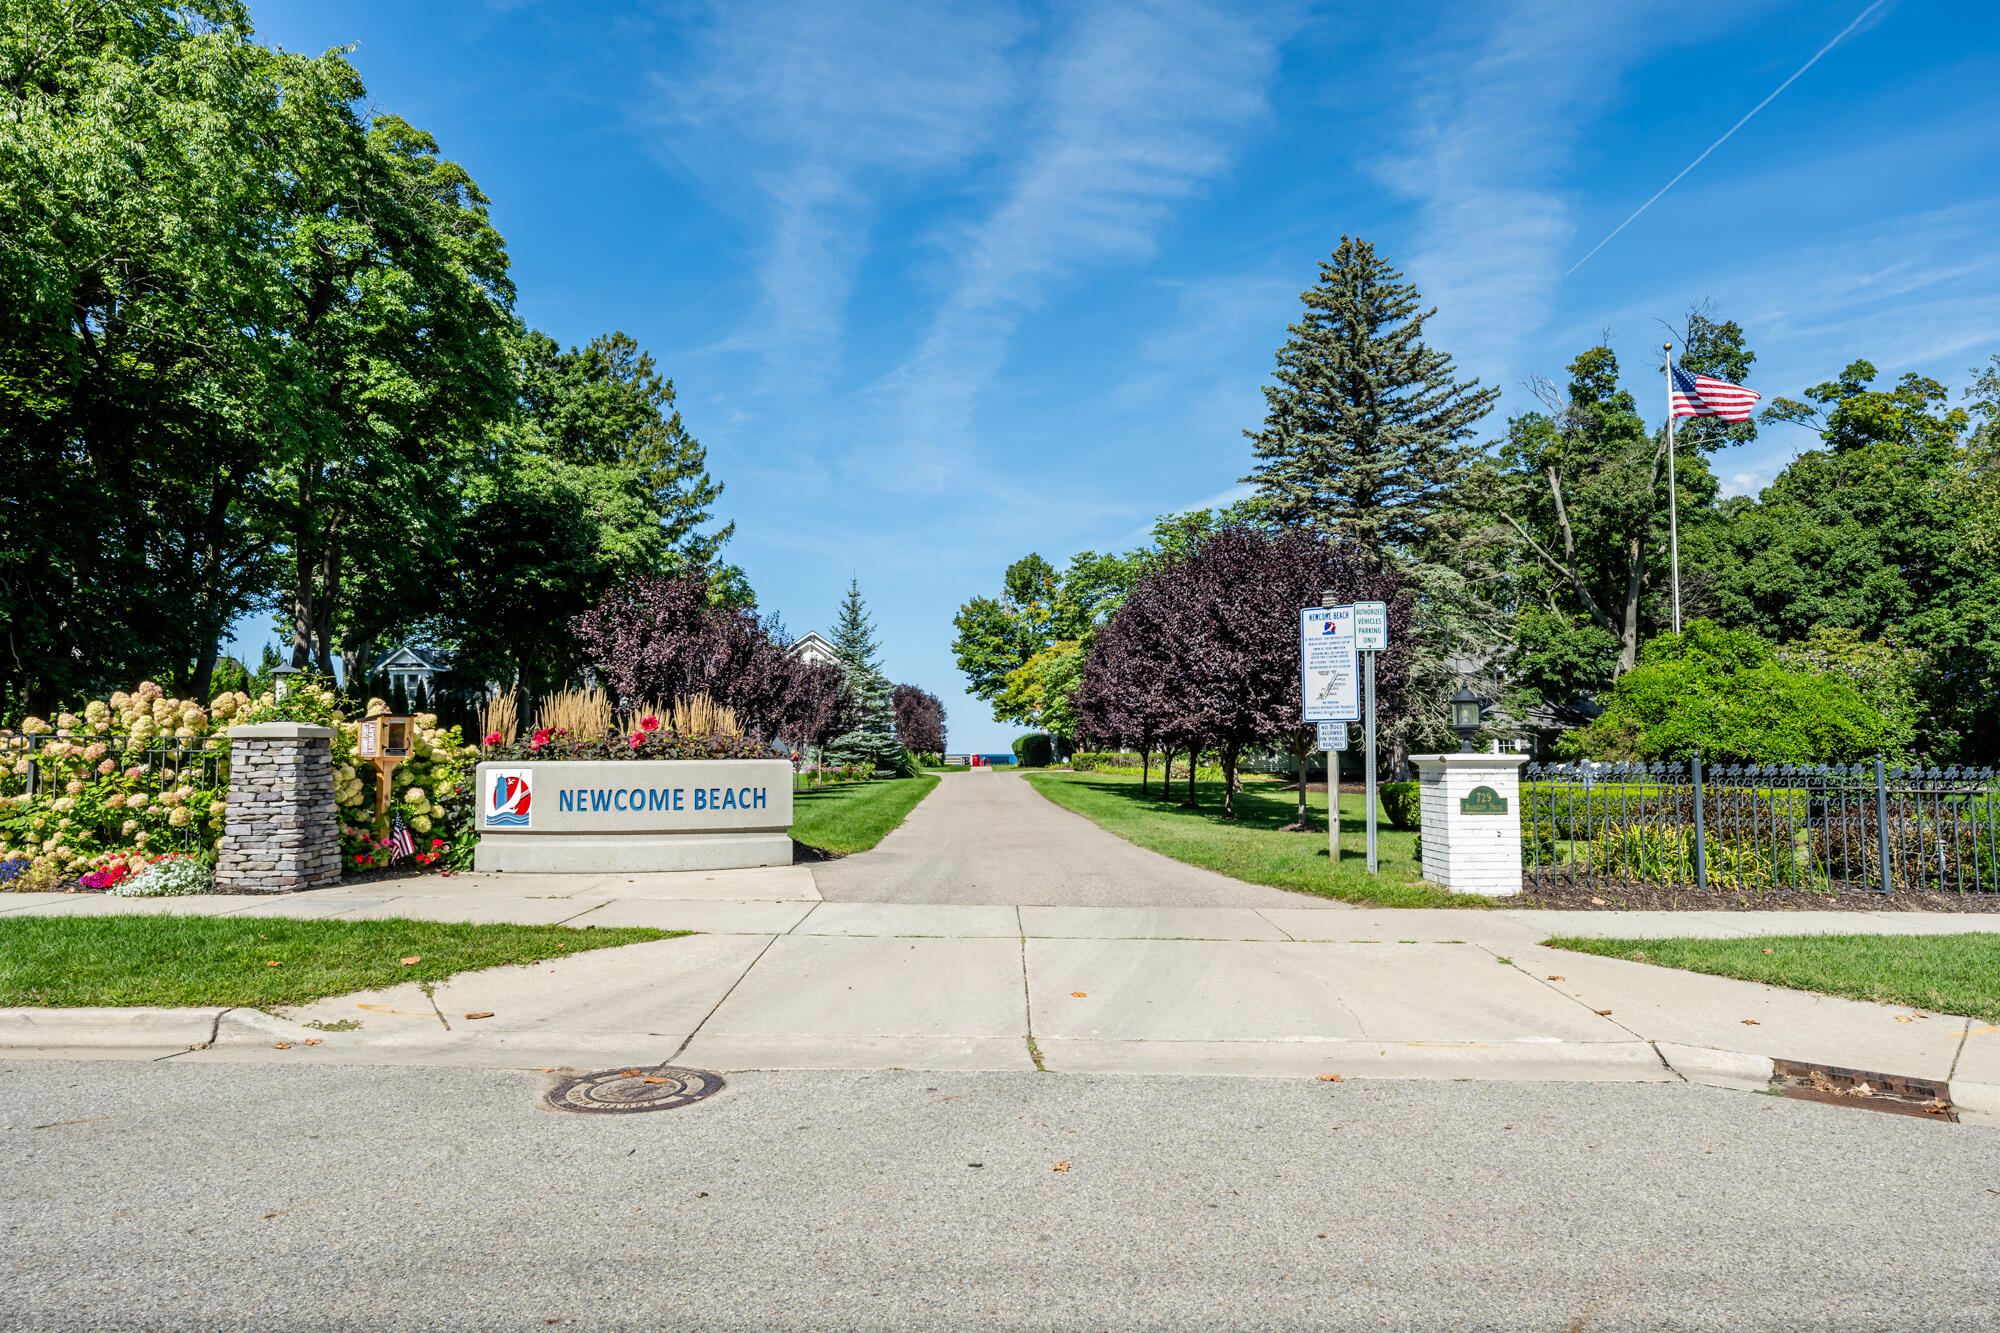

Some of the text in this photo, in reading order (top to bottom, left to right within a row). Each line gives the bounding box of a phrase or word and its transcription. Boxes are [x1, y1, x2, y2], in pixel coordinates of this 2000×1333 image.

[1309, 611, 1349, 621] NEWCOME BEACH
[559, 787, 767, 812] NEWCOME BEACH
[1476, 792, 1492, 803] 729
